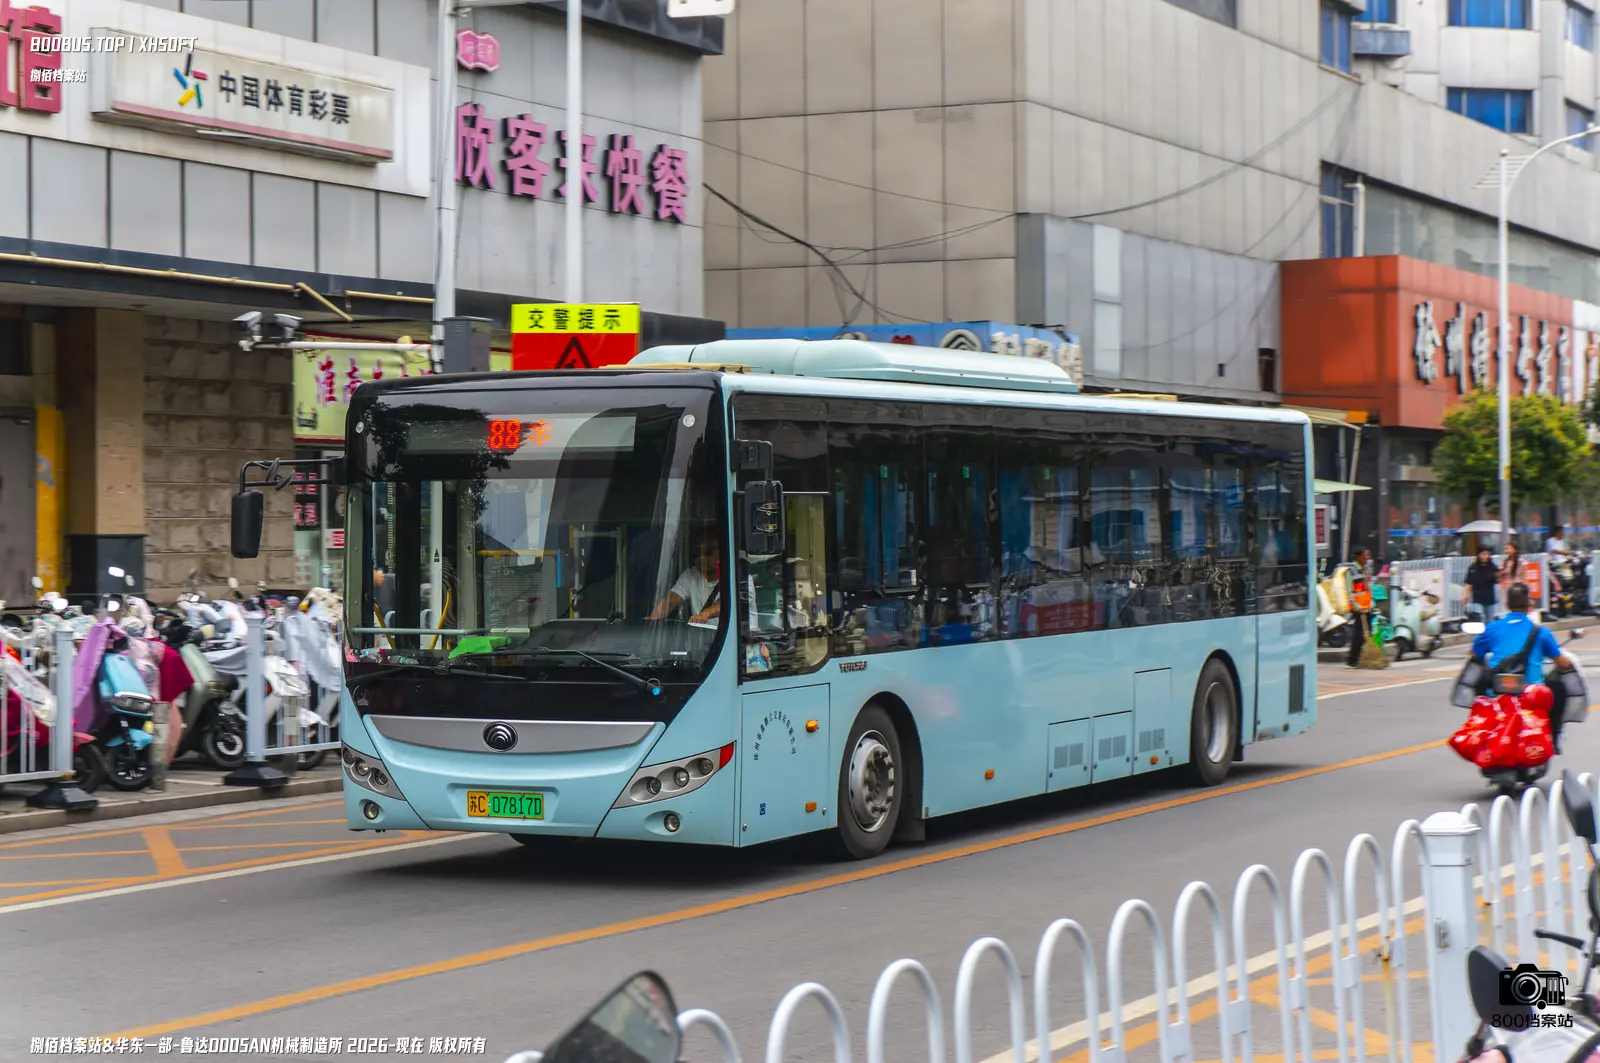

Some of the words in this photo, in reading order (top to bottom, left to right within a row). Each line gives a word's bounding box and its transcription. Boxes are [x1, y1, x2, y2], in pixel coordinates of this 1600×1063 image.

[219, 70, 350, 124] 中国体育彩票
[456, 102, 689, 223] 欣客来快餐
[528, 308, 621, 330] 交警提示
[489, 419, 521, 449] 88
